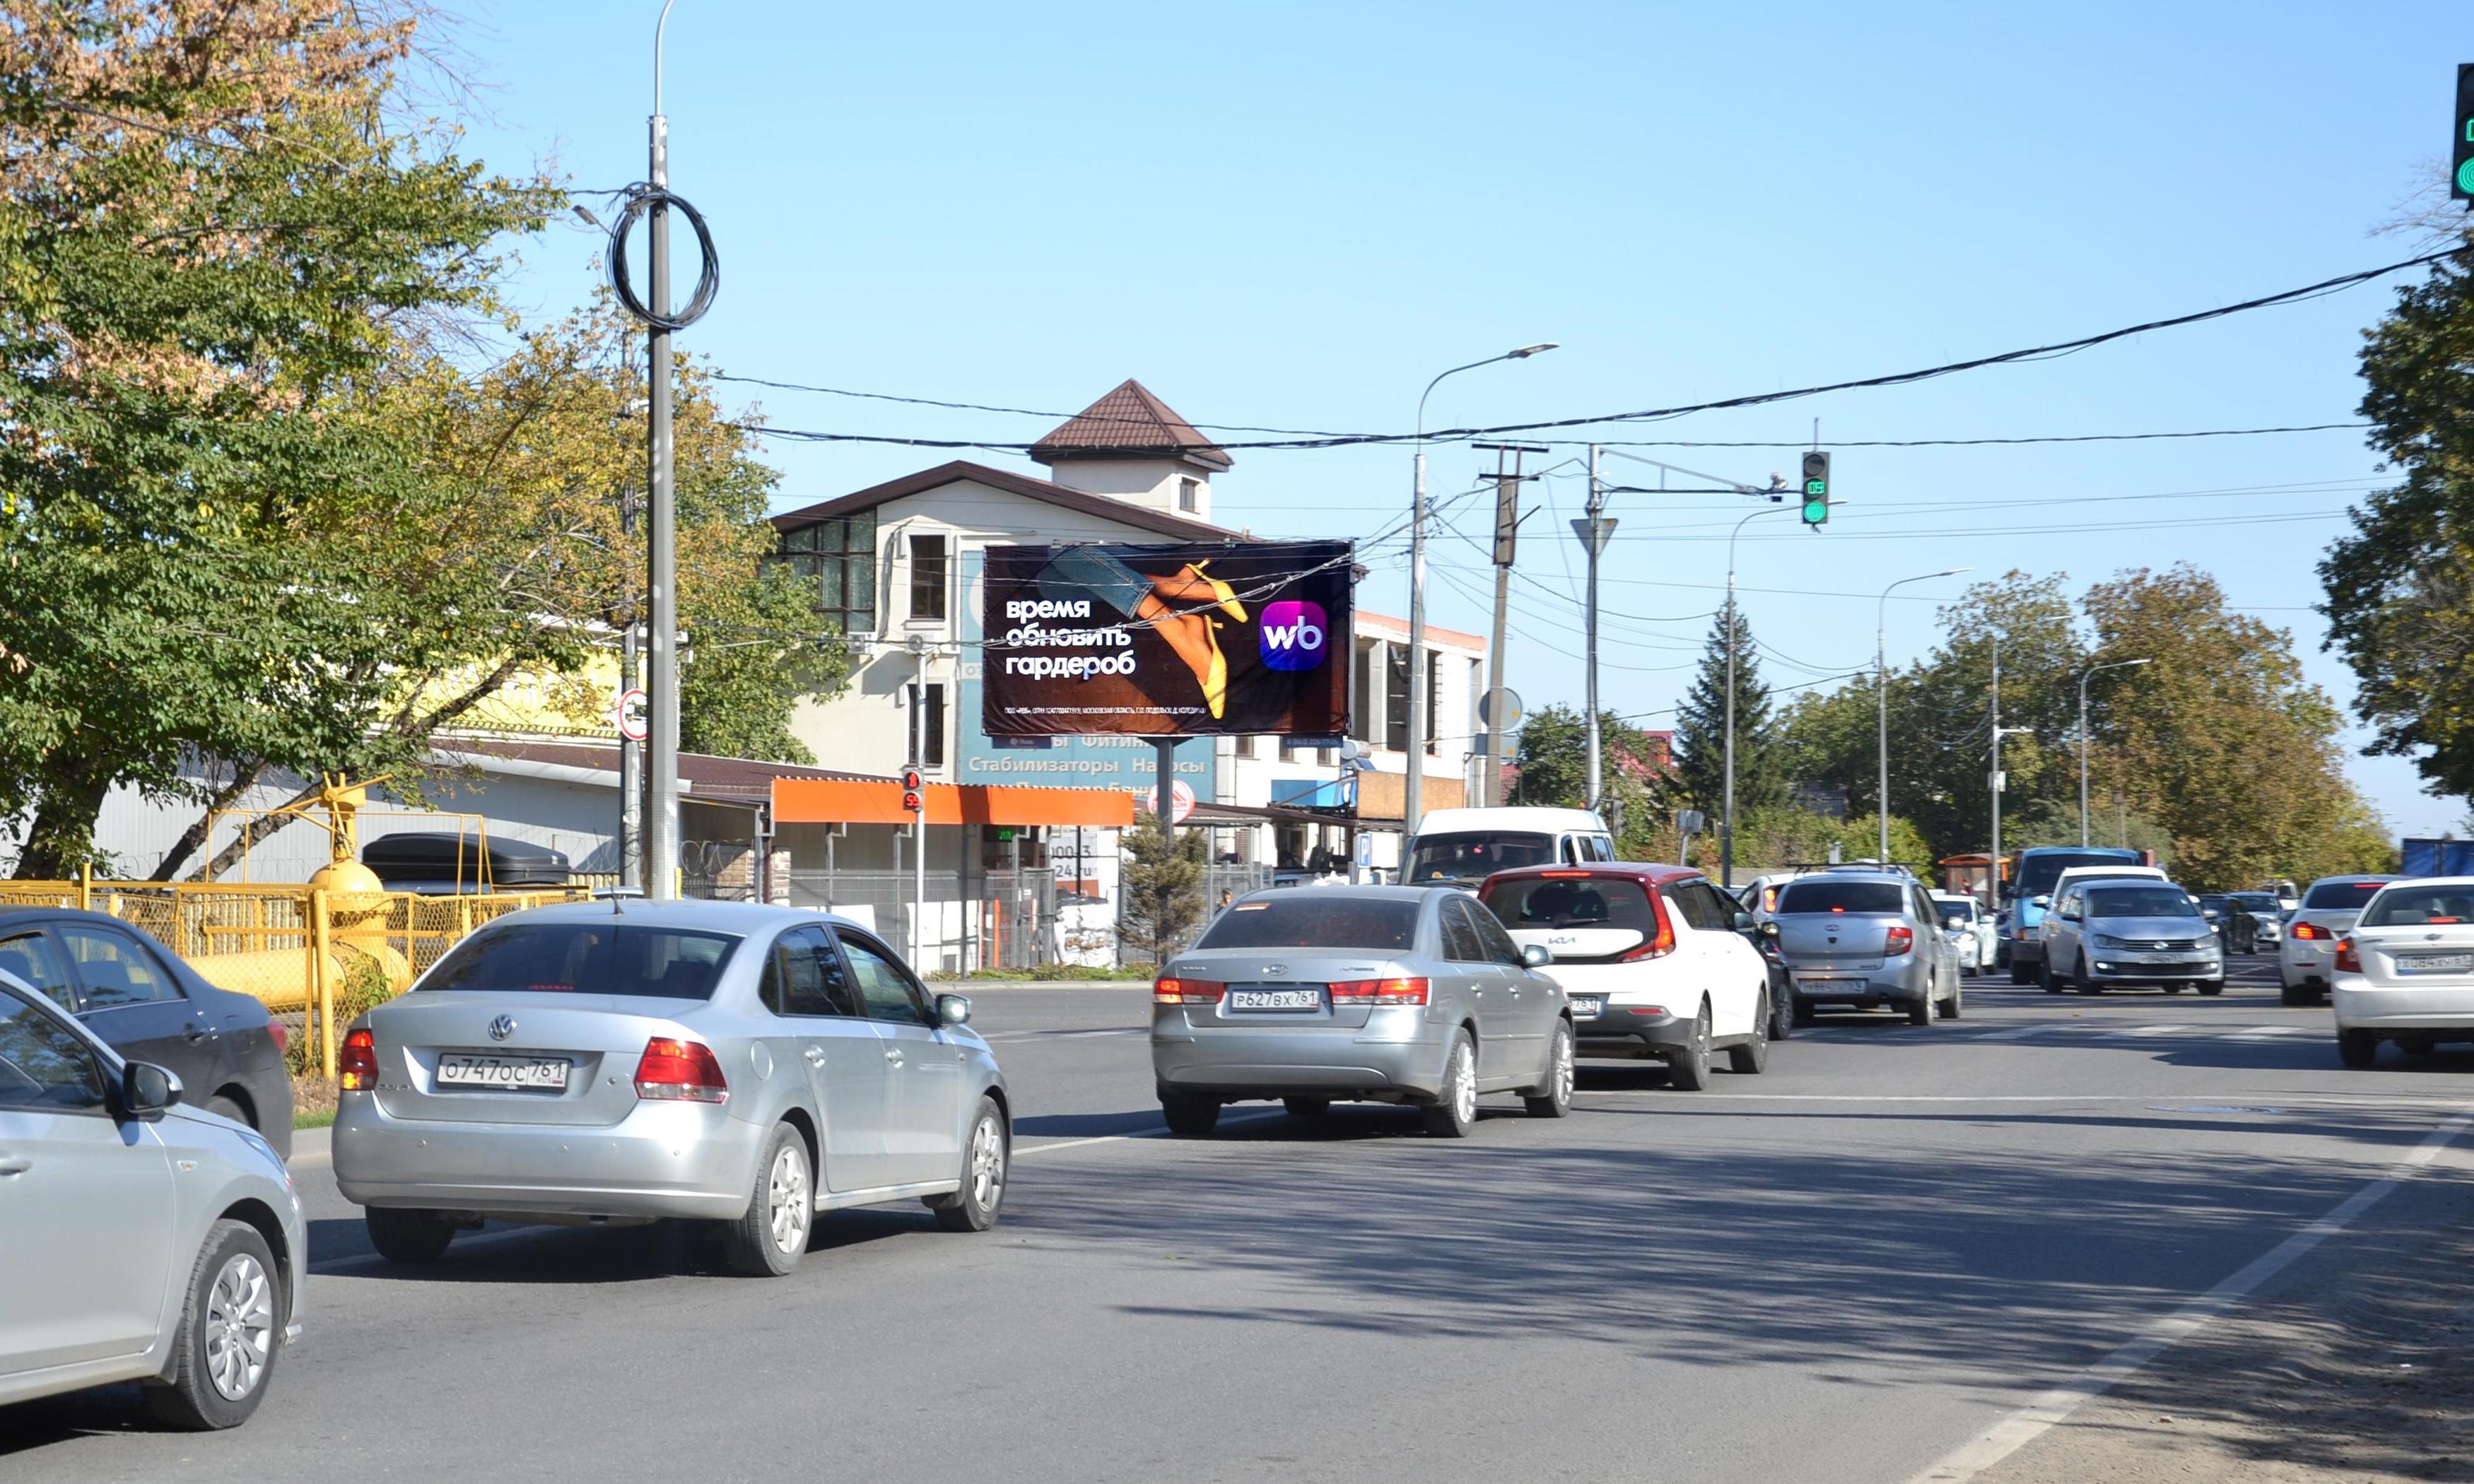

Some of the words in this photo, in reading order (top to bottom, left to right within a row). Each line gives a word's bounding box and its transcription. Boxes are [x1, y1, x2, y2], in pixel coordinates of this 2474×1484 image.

[1006, 600, 1091, 624] время
[1006, 622, 1132, 647] обновить
[1263, 616, 1323, 650] wb
[1006, 649, 1136, 681] гардероб
[969, 756, 1120, 775] Стабилизаторы
[1132, 758, 1205, 773] Насы
[531, 1061, 563, 1078] 761
